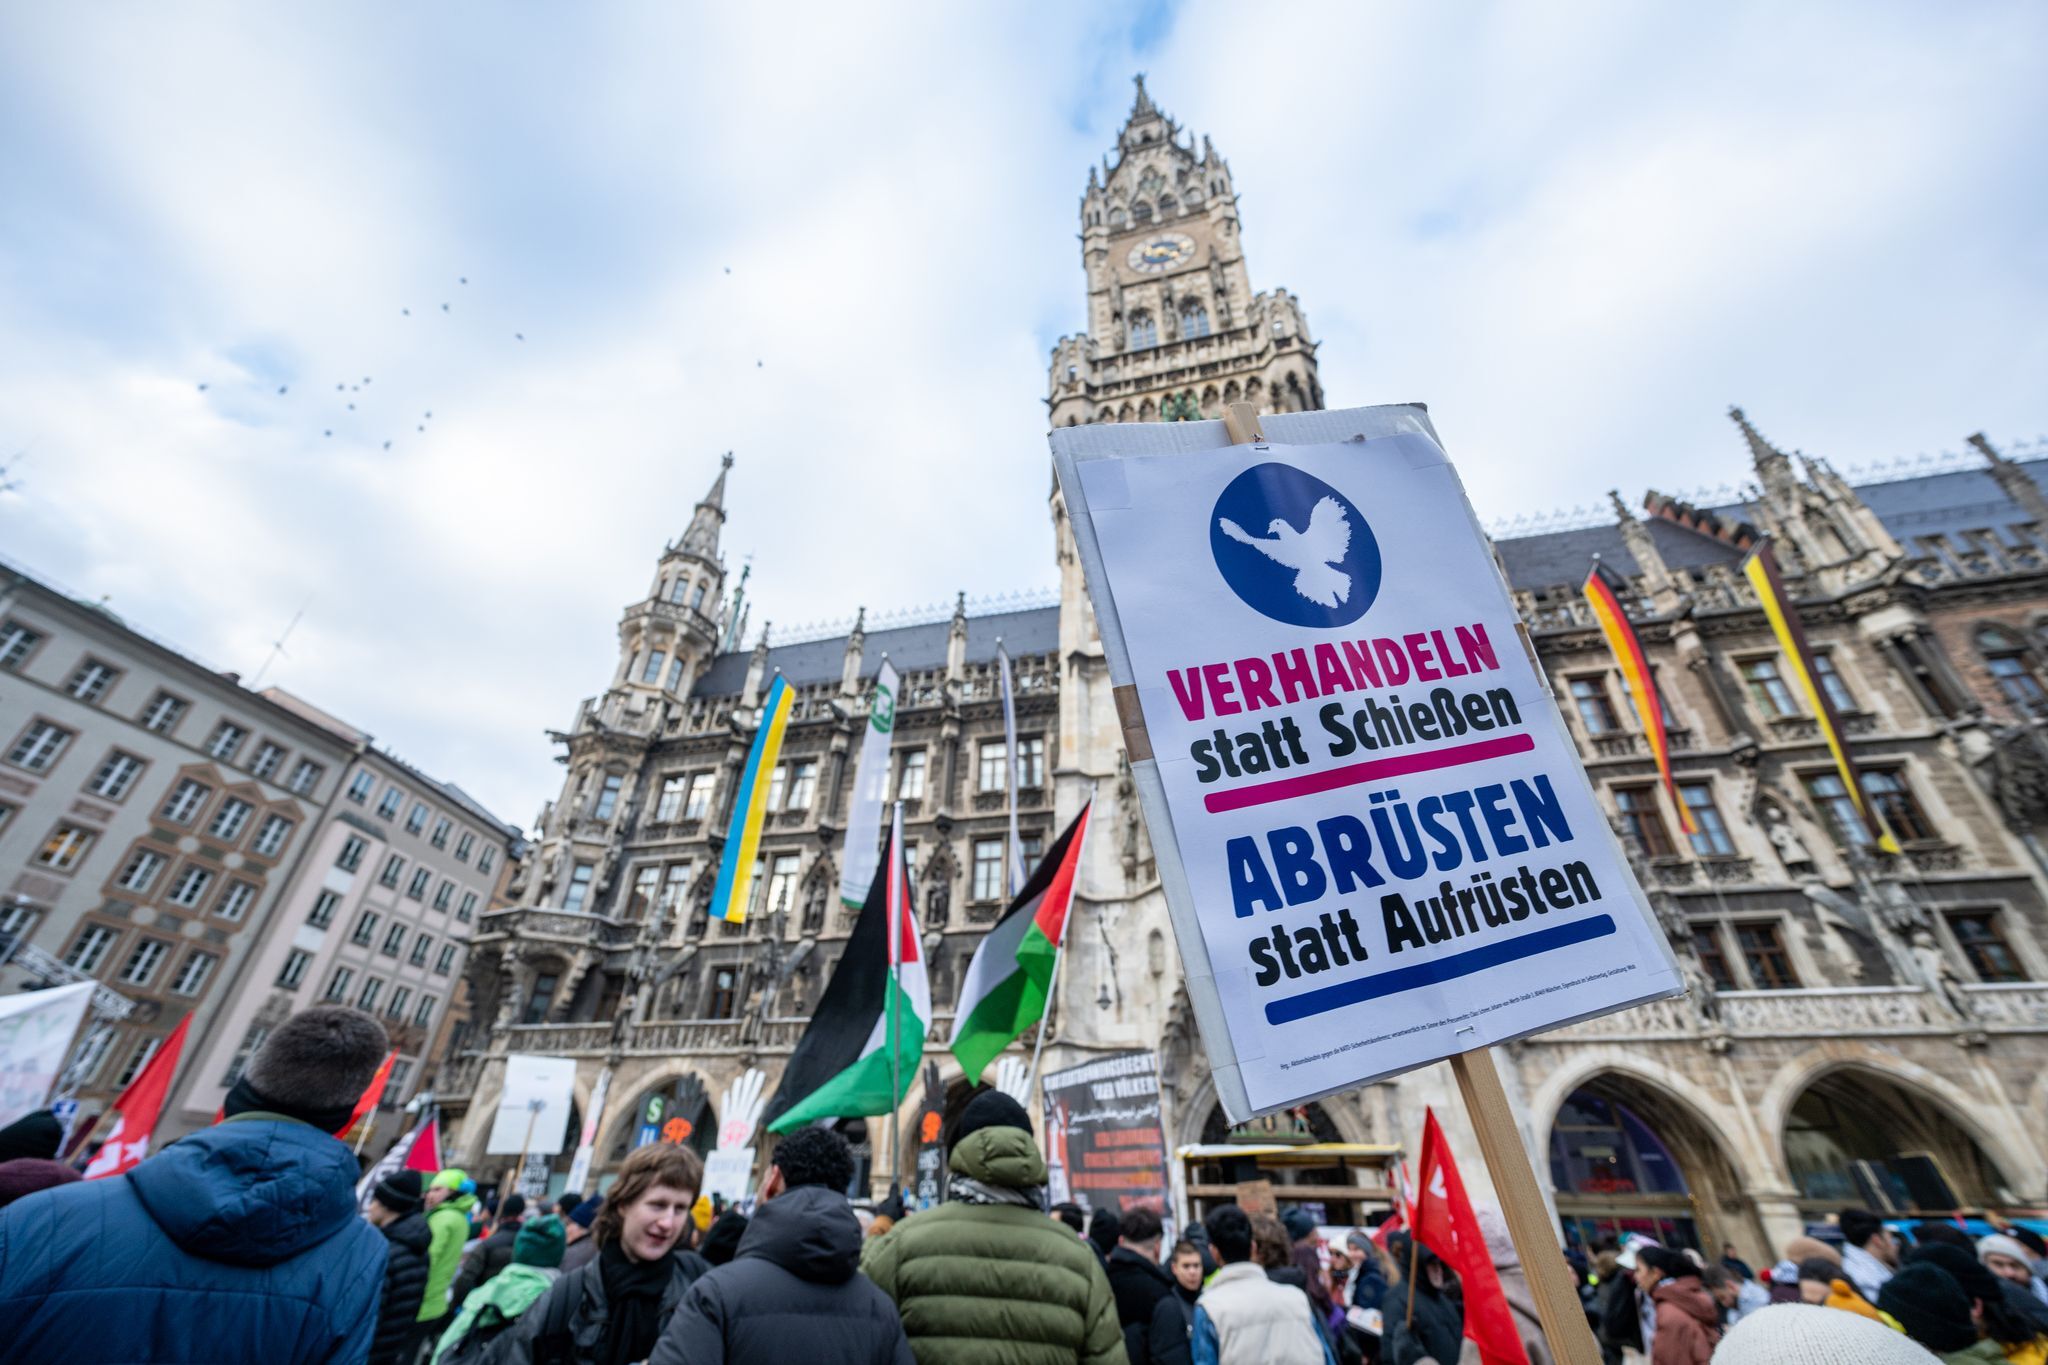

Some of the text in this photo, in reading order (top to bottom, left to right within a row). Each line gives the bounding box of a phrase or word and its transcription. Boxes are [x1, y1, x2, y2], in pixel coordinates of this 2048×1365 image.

[1166, 623, 1500, 721] VERHANDELN
[1191, 688, 1521, 782] statt Schießen
[1226, 774, 1574, 918] ABRÜSTEN
[1249, 861, 1601, 986] statt Aufrüsten
[646, 1097, 664, 1123] S
